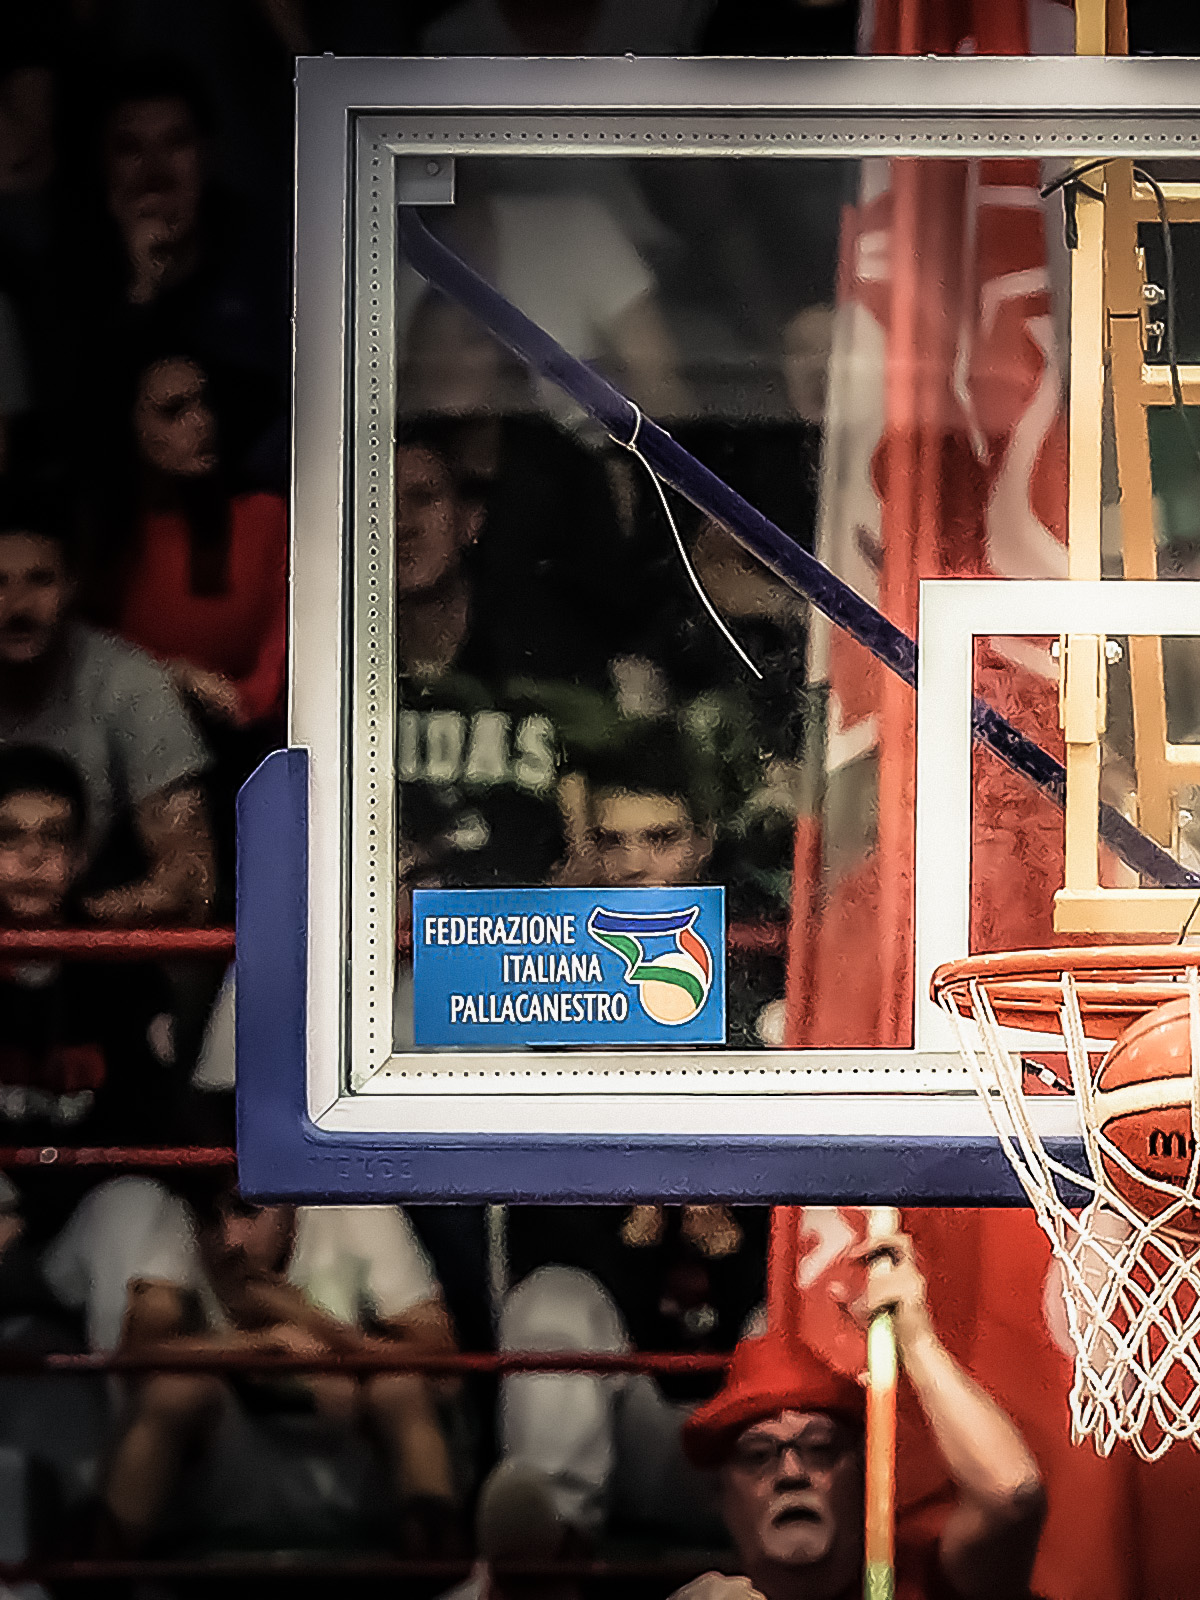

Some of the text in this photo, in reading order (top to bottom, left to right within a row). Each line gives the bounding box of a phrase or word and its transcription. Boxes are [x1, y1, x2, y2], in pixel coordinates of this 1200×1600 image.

[425, 915, 576, 945] FEDERAZIONE
[503, 954, 603, 983] ITALIANA
[450, 993, 628, 1023] PALLACANESTRO
